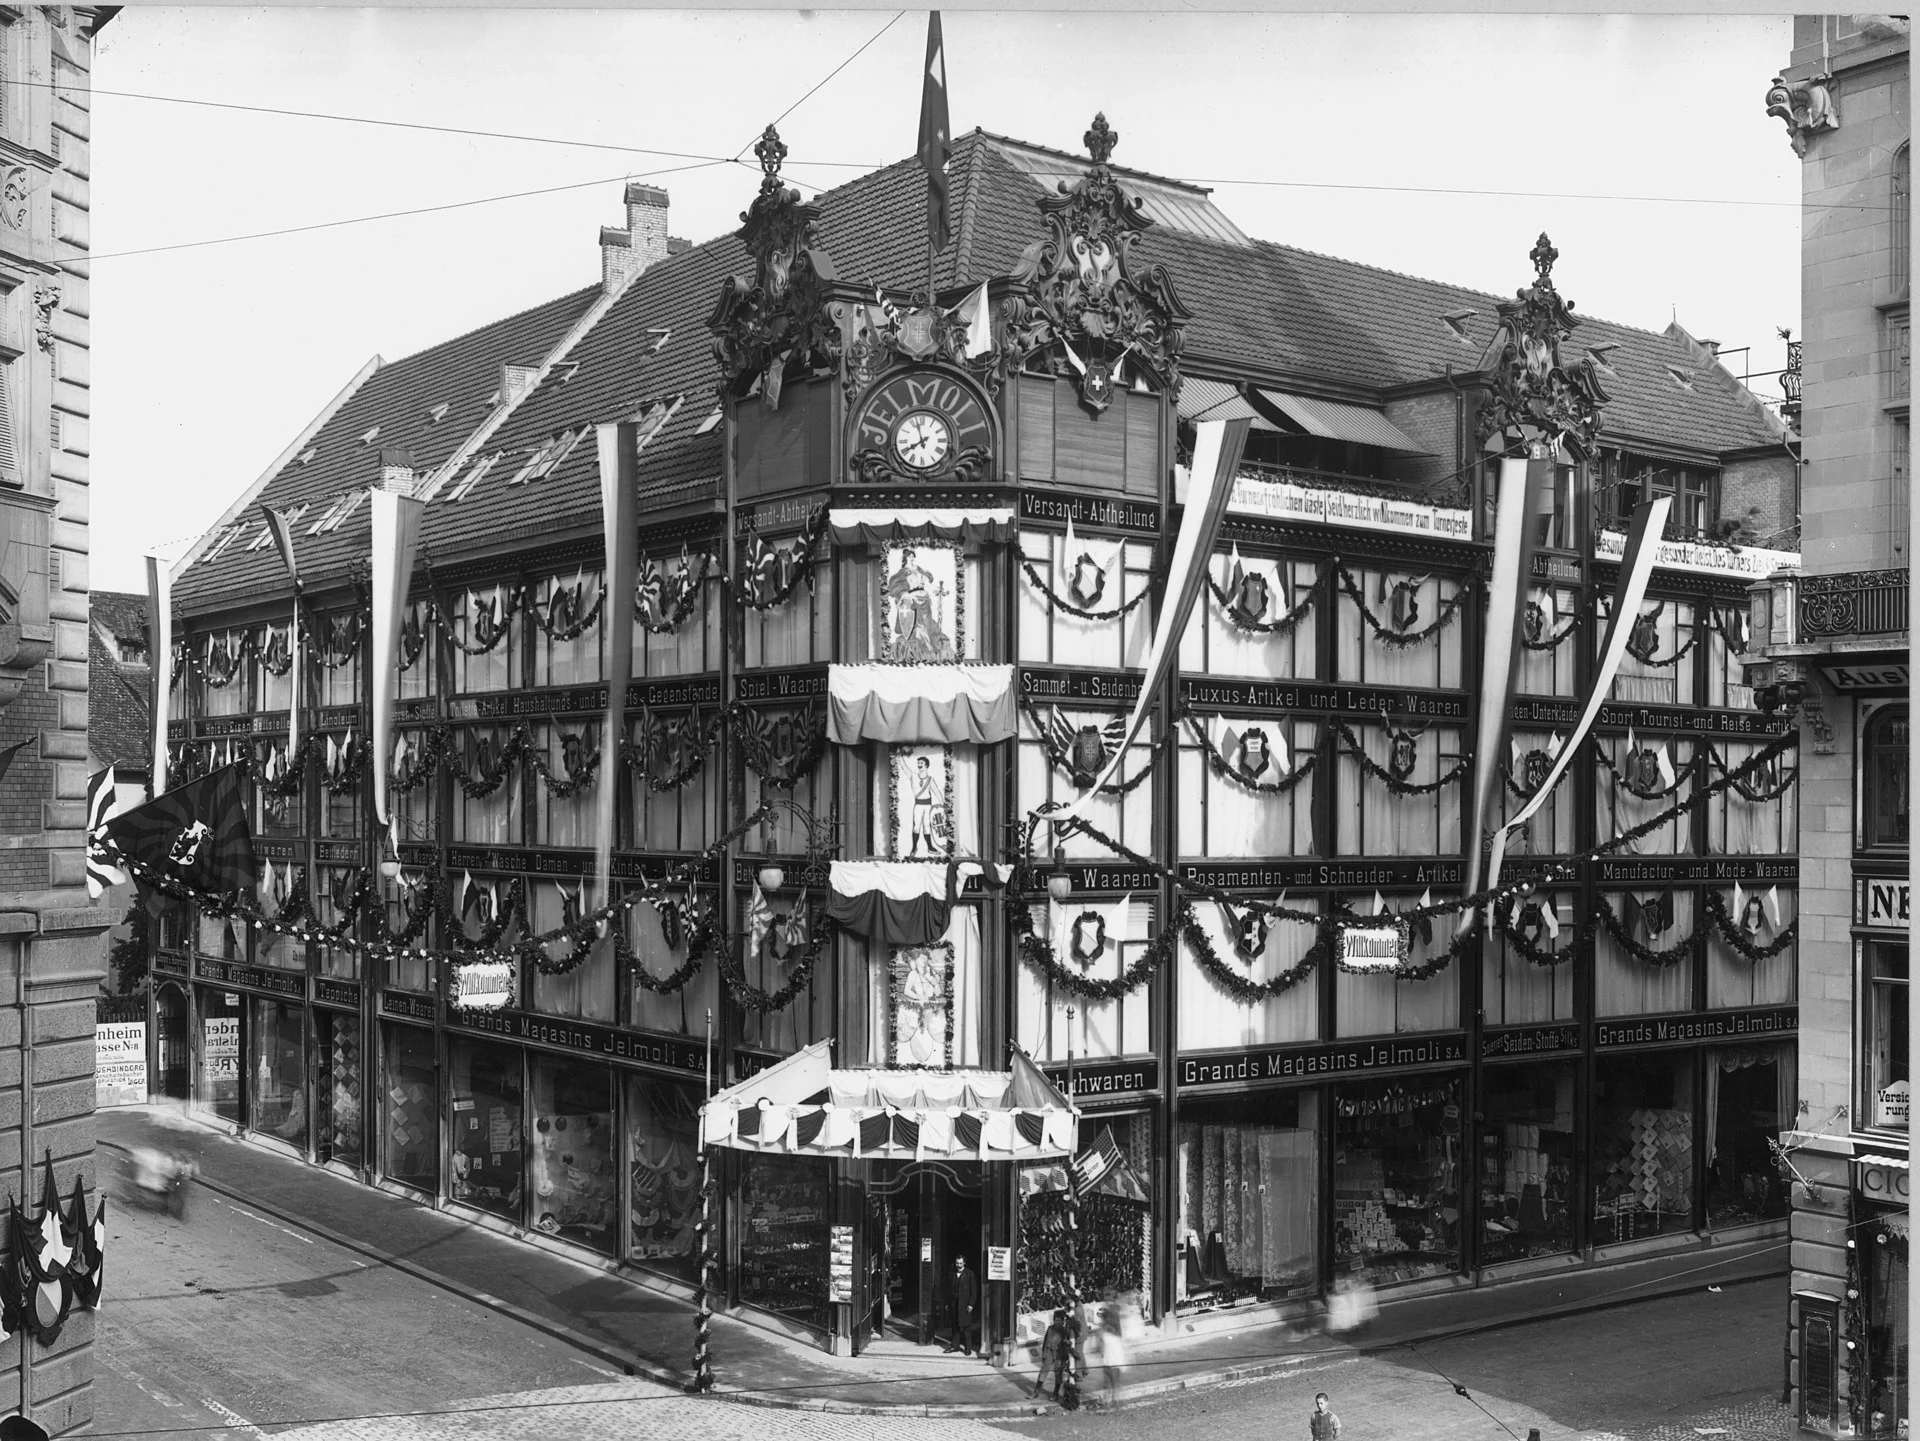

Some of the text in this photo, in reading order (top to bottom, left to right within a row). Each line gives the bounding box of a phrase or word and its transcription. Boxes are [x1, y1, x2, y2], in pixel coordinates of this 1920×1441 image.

[861, 378, 986, 446] JELMOLI
[1025, 494, 1156, 528] Versandt-Abtheilung
[1416, 514, 1429, 530] zum
[1433, 508, 1468, 537] Turnerfeste
[579, 694, 596, 709] und
[1188, 682, 1299, 707] Luxus-Artikel
[1310, 690, 1338, 708] und
[253, 716, 291, 732] Bettstelle
[320, 711, 358, 727] Linoleum
[390, 705, 435, 722] erren-Stoffe
[1693, 710, 1714, 730] und
[1721, 713, 1750, 732] Reise
[1295, 868, 1312, 885] und
[1319, 866, 1393, 884] Schneider
[1416, 864, 1461, 883] Artikel
[1688, 865, 1709, 878] und
[200, 961, 224, 979] Grands
[319, 982, 358, 1004] Teppiche
[97, 1026, 142, 1040] nheim
[462, 1010, 511, 1033] Grands
[521, 1017, 592, 1048] Magasins
[603, 1033, 676, 1065] Jelmoli
[1599, 1022, 1652, 1045] Grands
[1657, 1020, 1723, 1040] Magasins
[1726, 1015, 1783, 1033] Jelmoli
[95, 1044, 121, 1053] asse
[1503, 1030, 1559, 1053] Seiden-Stoffe
[1185, 1056, 1260, 1083] Grands
[1267, 1050, 1358, 1075] Magasins
[1363, 1041, 1440, 1066] Jelmoli
[1055, 1072, 1144, 1094] huhwaren
